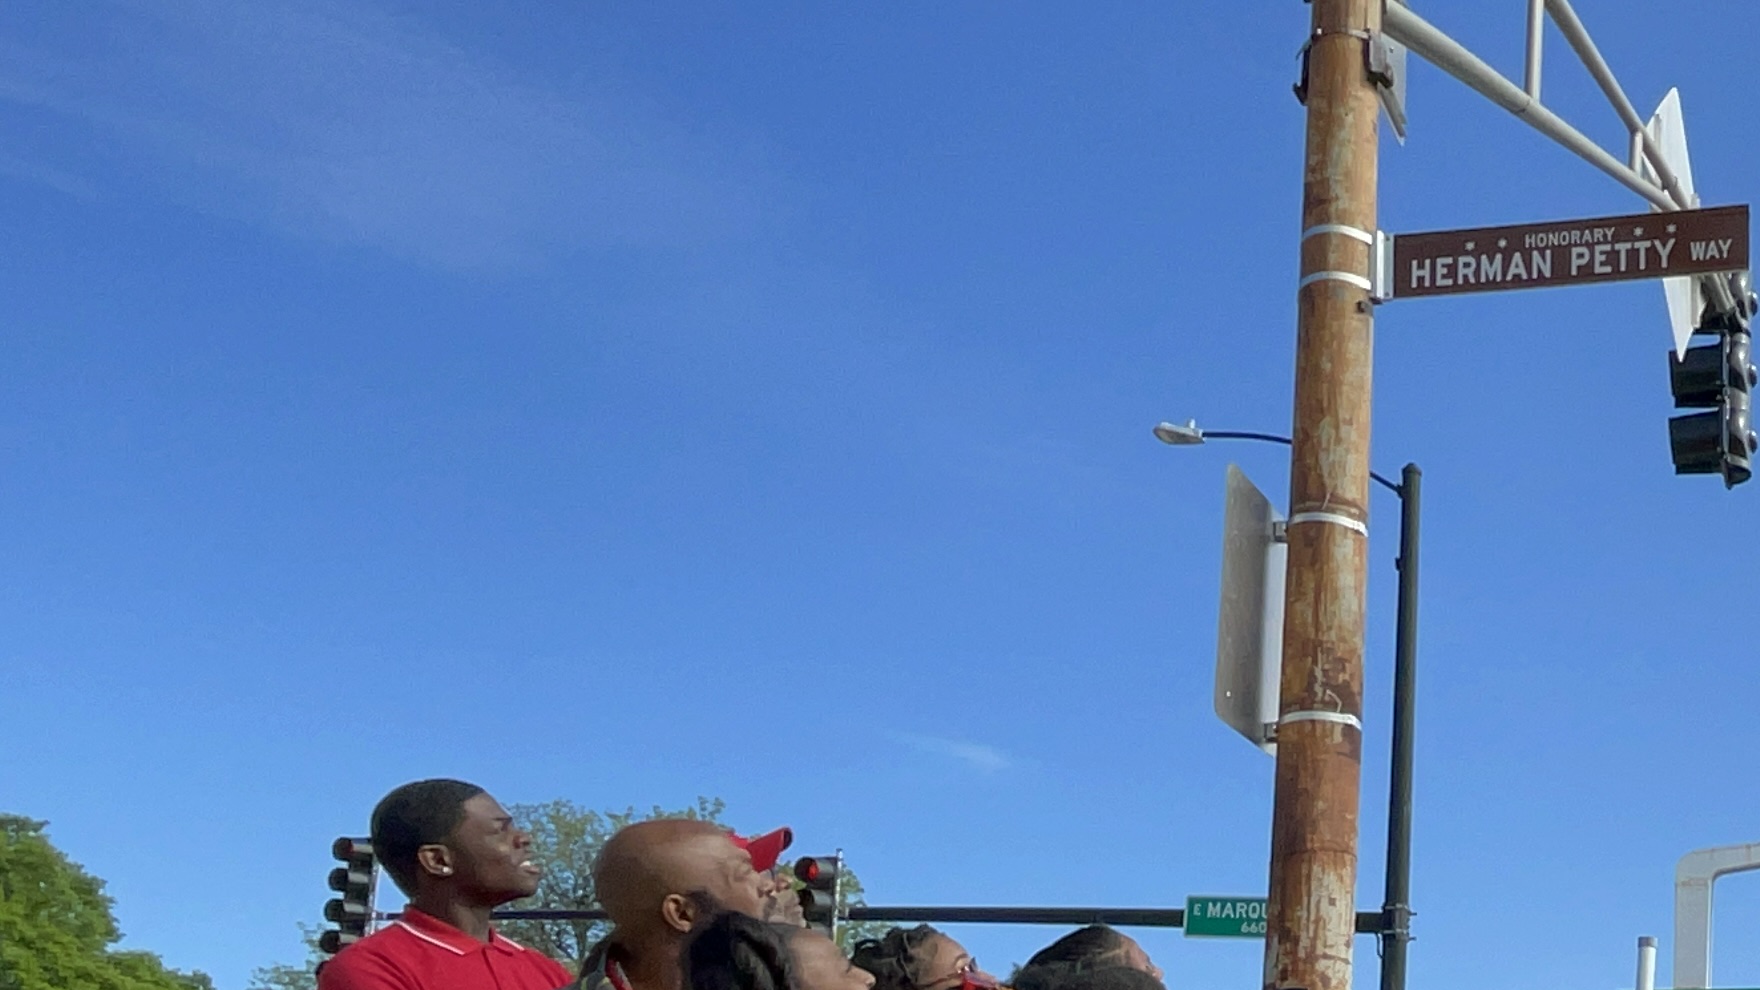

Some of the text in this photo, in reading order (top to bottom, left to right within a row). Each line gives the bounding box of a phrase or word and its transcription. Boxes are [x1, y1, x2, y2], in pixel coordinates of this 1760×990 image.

[1525, 227, 1615, 248] HONORARY
[1411, 239, 1732, 288] HERMAN PETTY WAY
[1193, 904, 1201, 915] E
